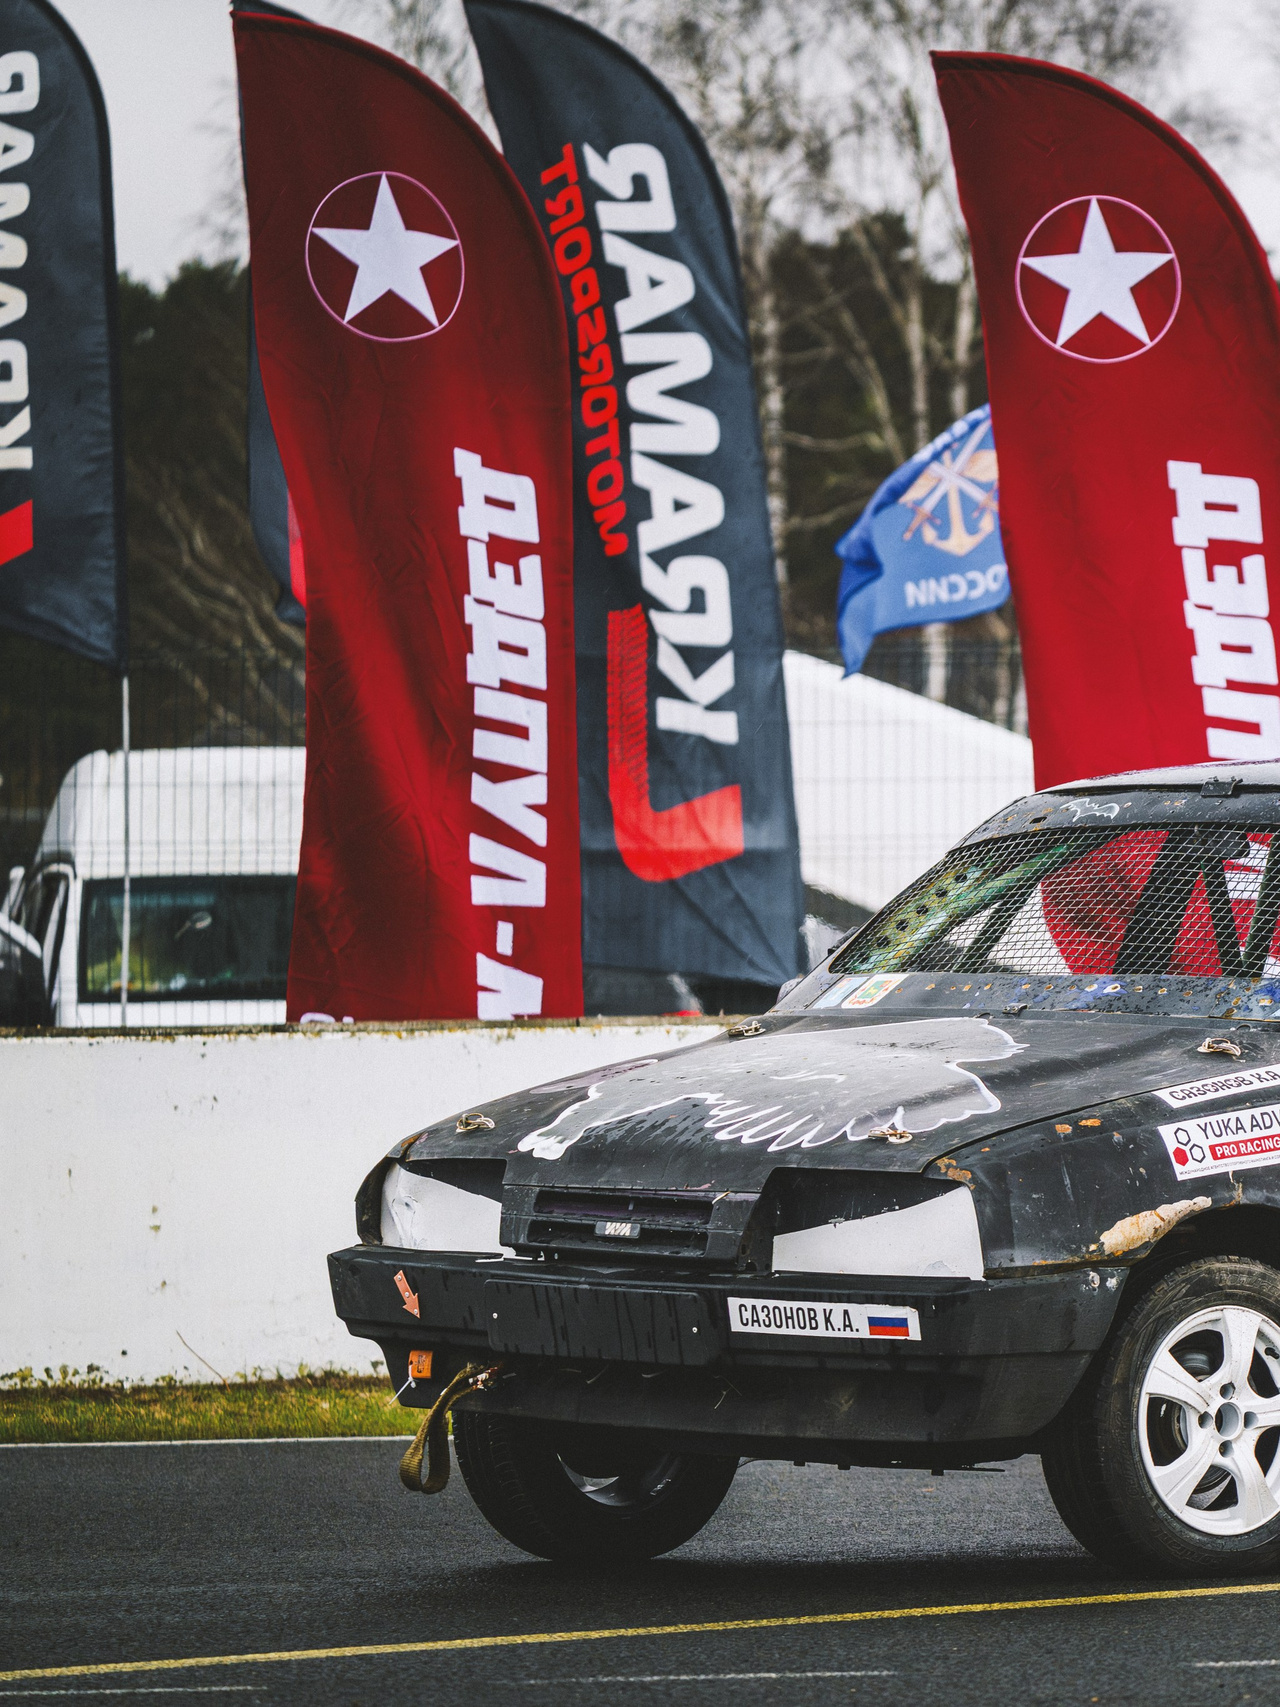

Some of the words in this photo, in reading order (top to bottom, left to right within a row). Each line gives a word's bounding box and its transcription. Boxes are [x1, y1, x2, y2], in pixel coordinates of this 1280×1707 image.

[1169, 1076, 1254, 1101] САЗОНОВ
[1197, 1117, 1247, 1140] YUKA
[1215, 1144, 1238, 1158] PRO
[738, 1303, 819, 1331] САЗОНОВ
[823, 1308, 860, 1333] К.А.
